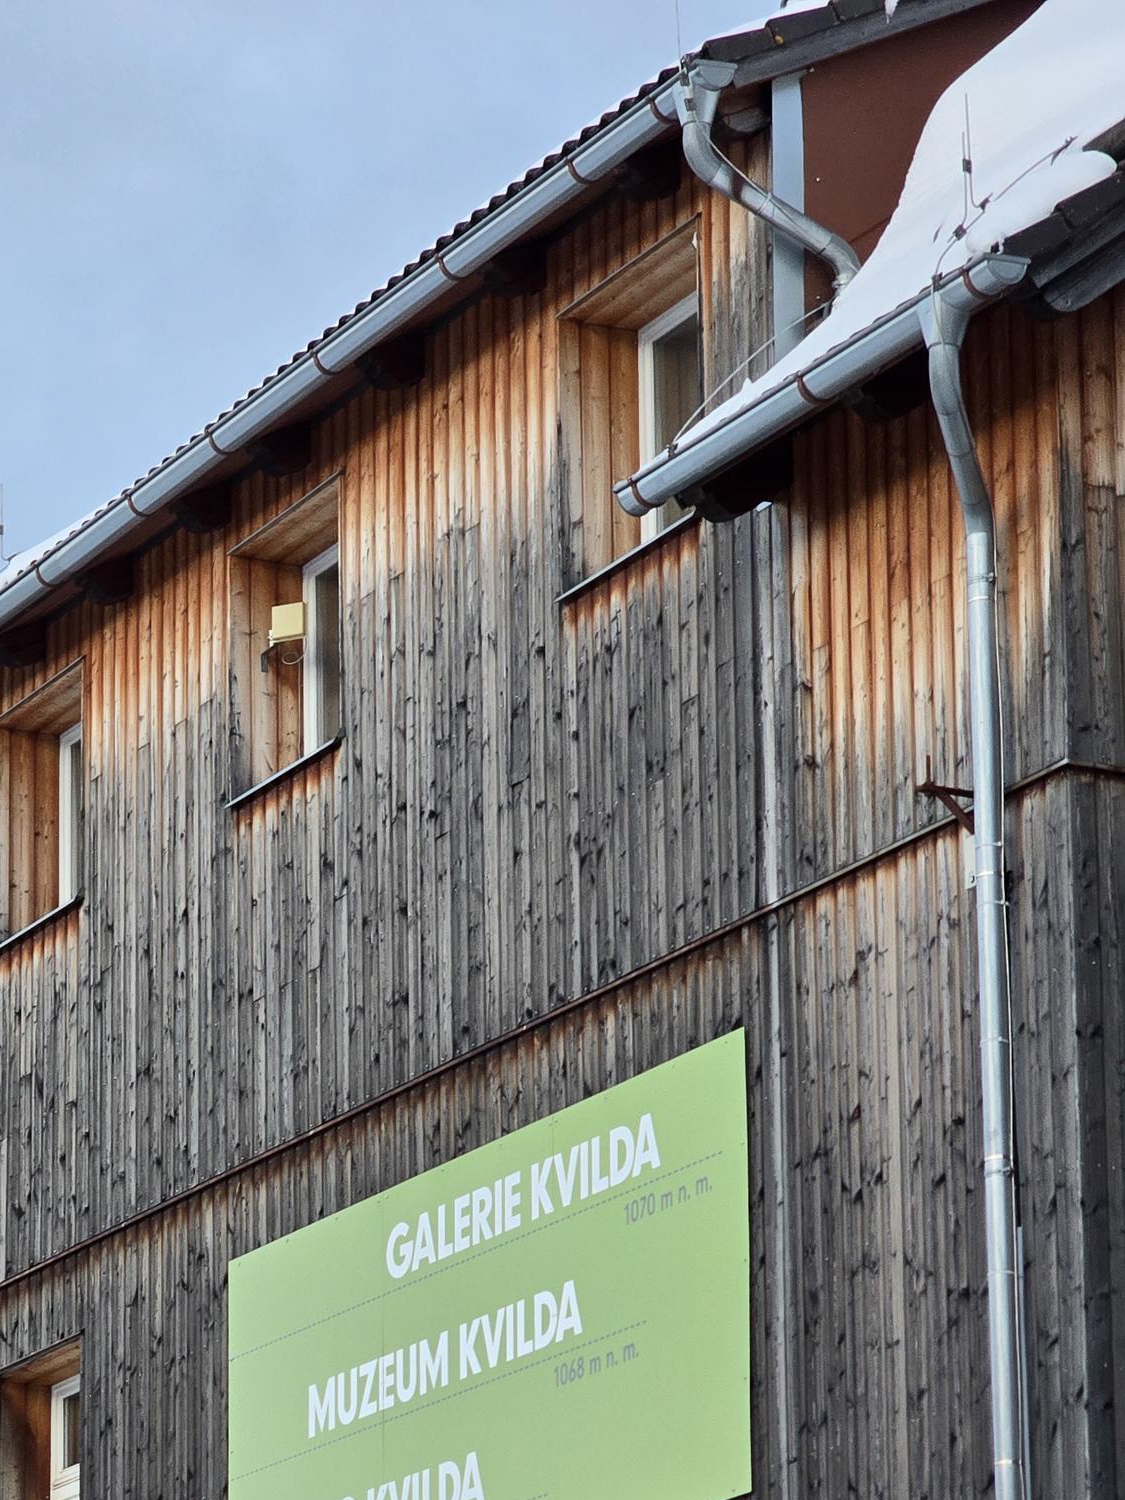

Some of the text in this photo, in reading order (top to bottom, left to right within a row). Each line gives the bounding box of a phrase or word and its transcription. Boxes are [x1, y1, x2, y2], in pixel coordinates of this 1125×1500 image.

[386, 1113, 661, 1279] GALERIE KVILDA
[624, 1176, 712, 1225] 1070 m n. m.
[308, 1279, 583, 1439] MUZEUM KVILDA
[553, 1341, 639, 1387] 1068 m n. m.
